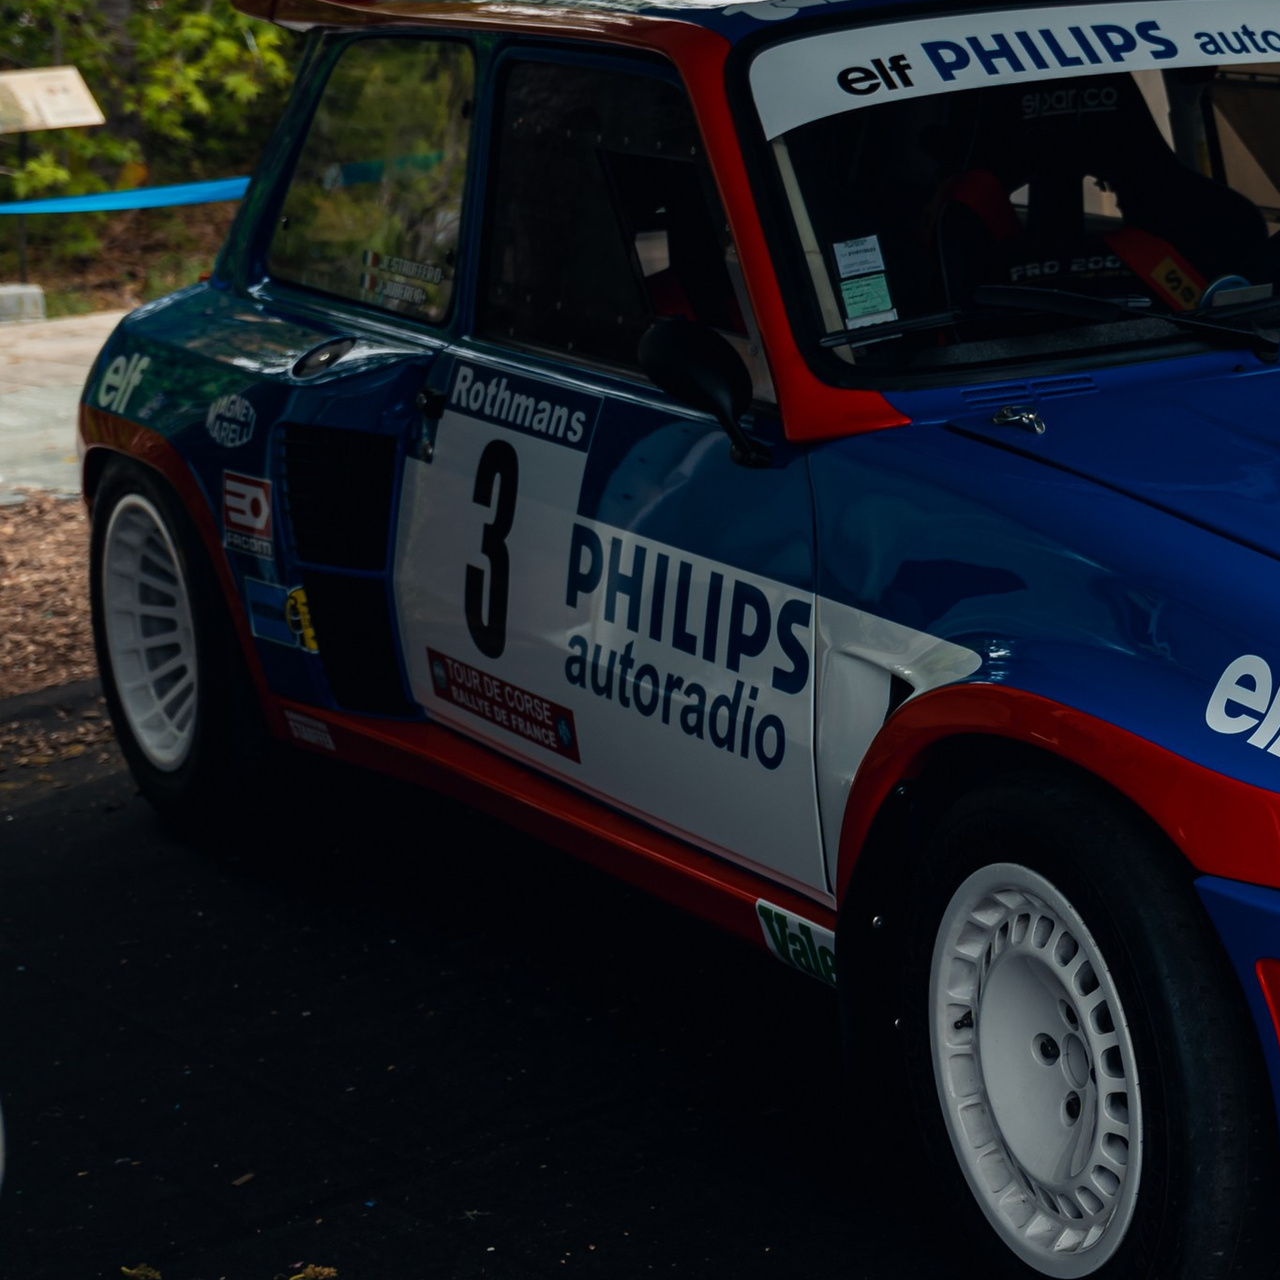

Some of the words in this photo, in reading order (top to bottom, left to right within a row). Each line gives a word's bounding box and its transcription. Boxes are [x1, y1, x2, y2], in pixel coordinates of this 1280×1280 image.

[837, 55, 914, 96] elf
[921, 21, 1178, 81] PHILIPS
[1009, 260, 1060, 282] PRO
[97, 353, 151, 414] elf
[451, 365, 586, 443] Rothmans
[465, 439, 519, 659] 3
[566, 523, 812, 695] PHILIPS
[445, 657, 483, 693] TOUR
[482, 676, 504, 703] DE
[504, 685, 554, 726] CORSE
[451, 683, 493, 718] RALLYE
[493, 705, 509, 726] DE
[511, 712, 558, 748] FRANCE
[565, 635, 785, 770] autoradio
[757, 903, 837, 985] Vale
